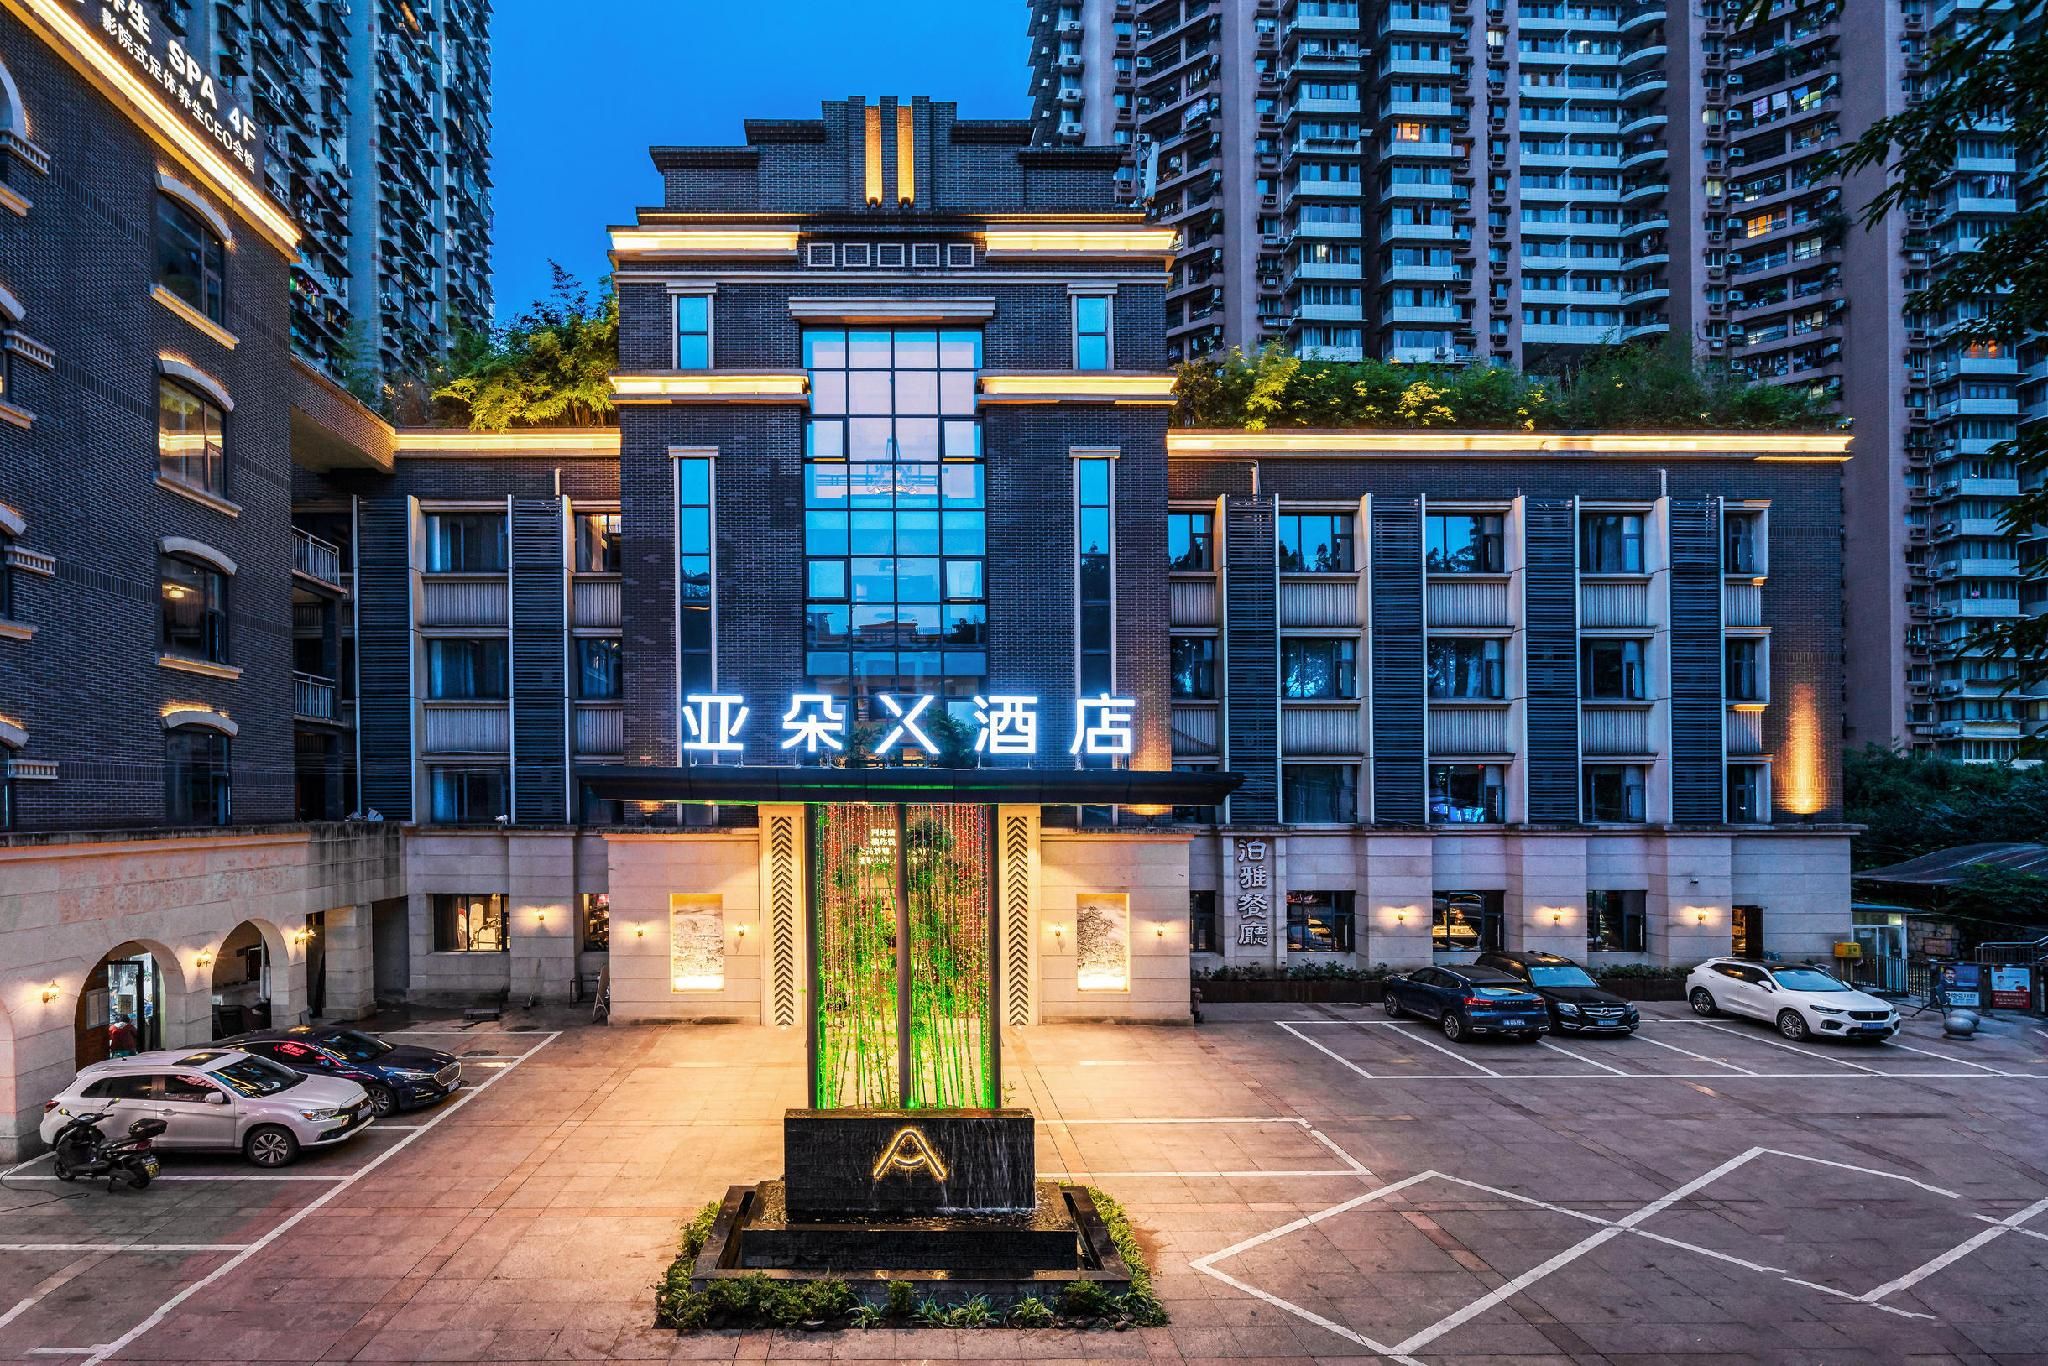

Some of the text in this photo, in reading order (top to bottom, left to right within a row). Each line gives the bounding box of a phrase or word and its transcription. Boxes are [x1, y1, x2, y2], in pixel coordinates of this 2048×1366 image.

[168, 39, 218, 110] SPA
[229, 107, 256, 141] 4F
[682, 693, 1136, 755] 亚朵X酒店
[1238, 839, 1268, 946] 泊雅餐廳
